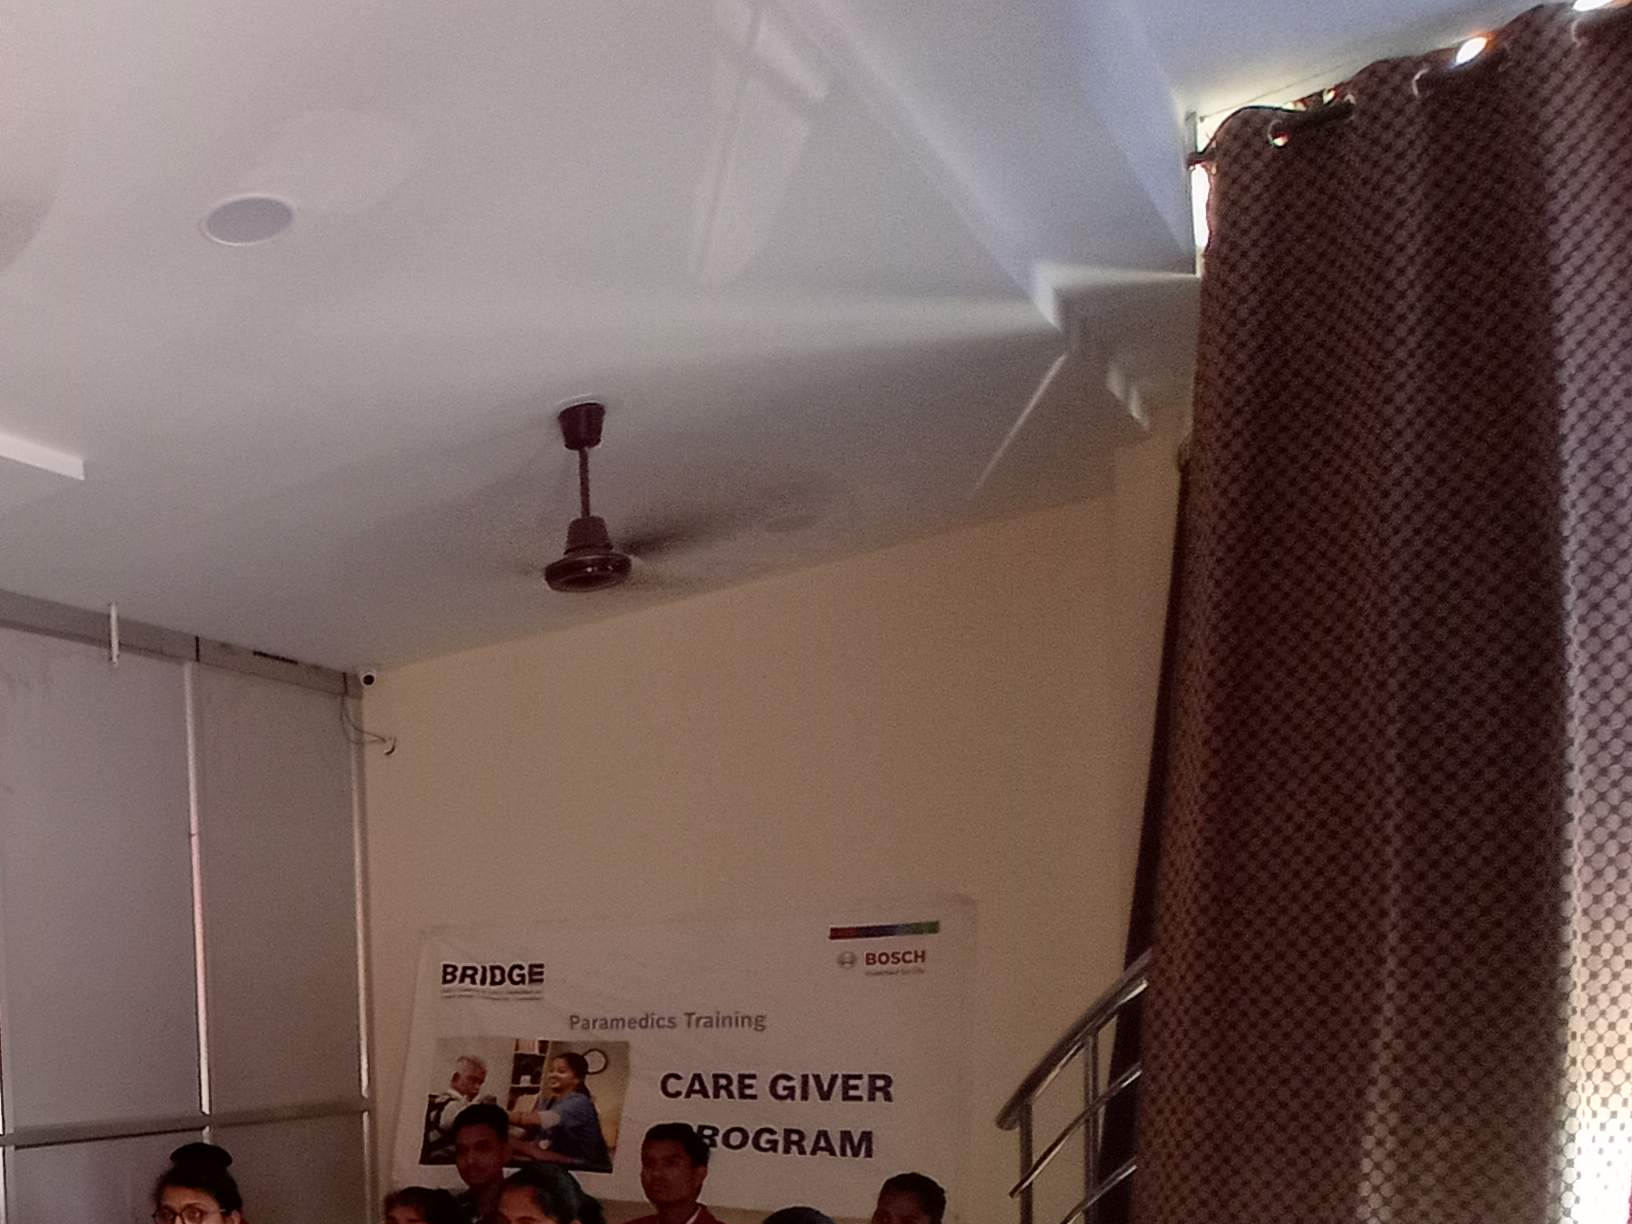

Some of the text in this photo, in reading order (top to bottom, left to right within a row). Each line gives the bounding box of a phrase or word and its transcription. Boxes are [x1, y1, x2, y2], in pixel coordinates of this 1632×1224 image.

[865, 950, 926, 966] BOSCH
[441, 963, 545, 987] BRIDGE
[569, 1011, 767, 1032] Paramedics Training
[660, 1073, 894, 1102] CARE GIVER
[697, 1124, 873, 1159] ROGRAM
